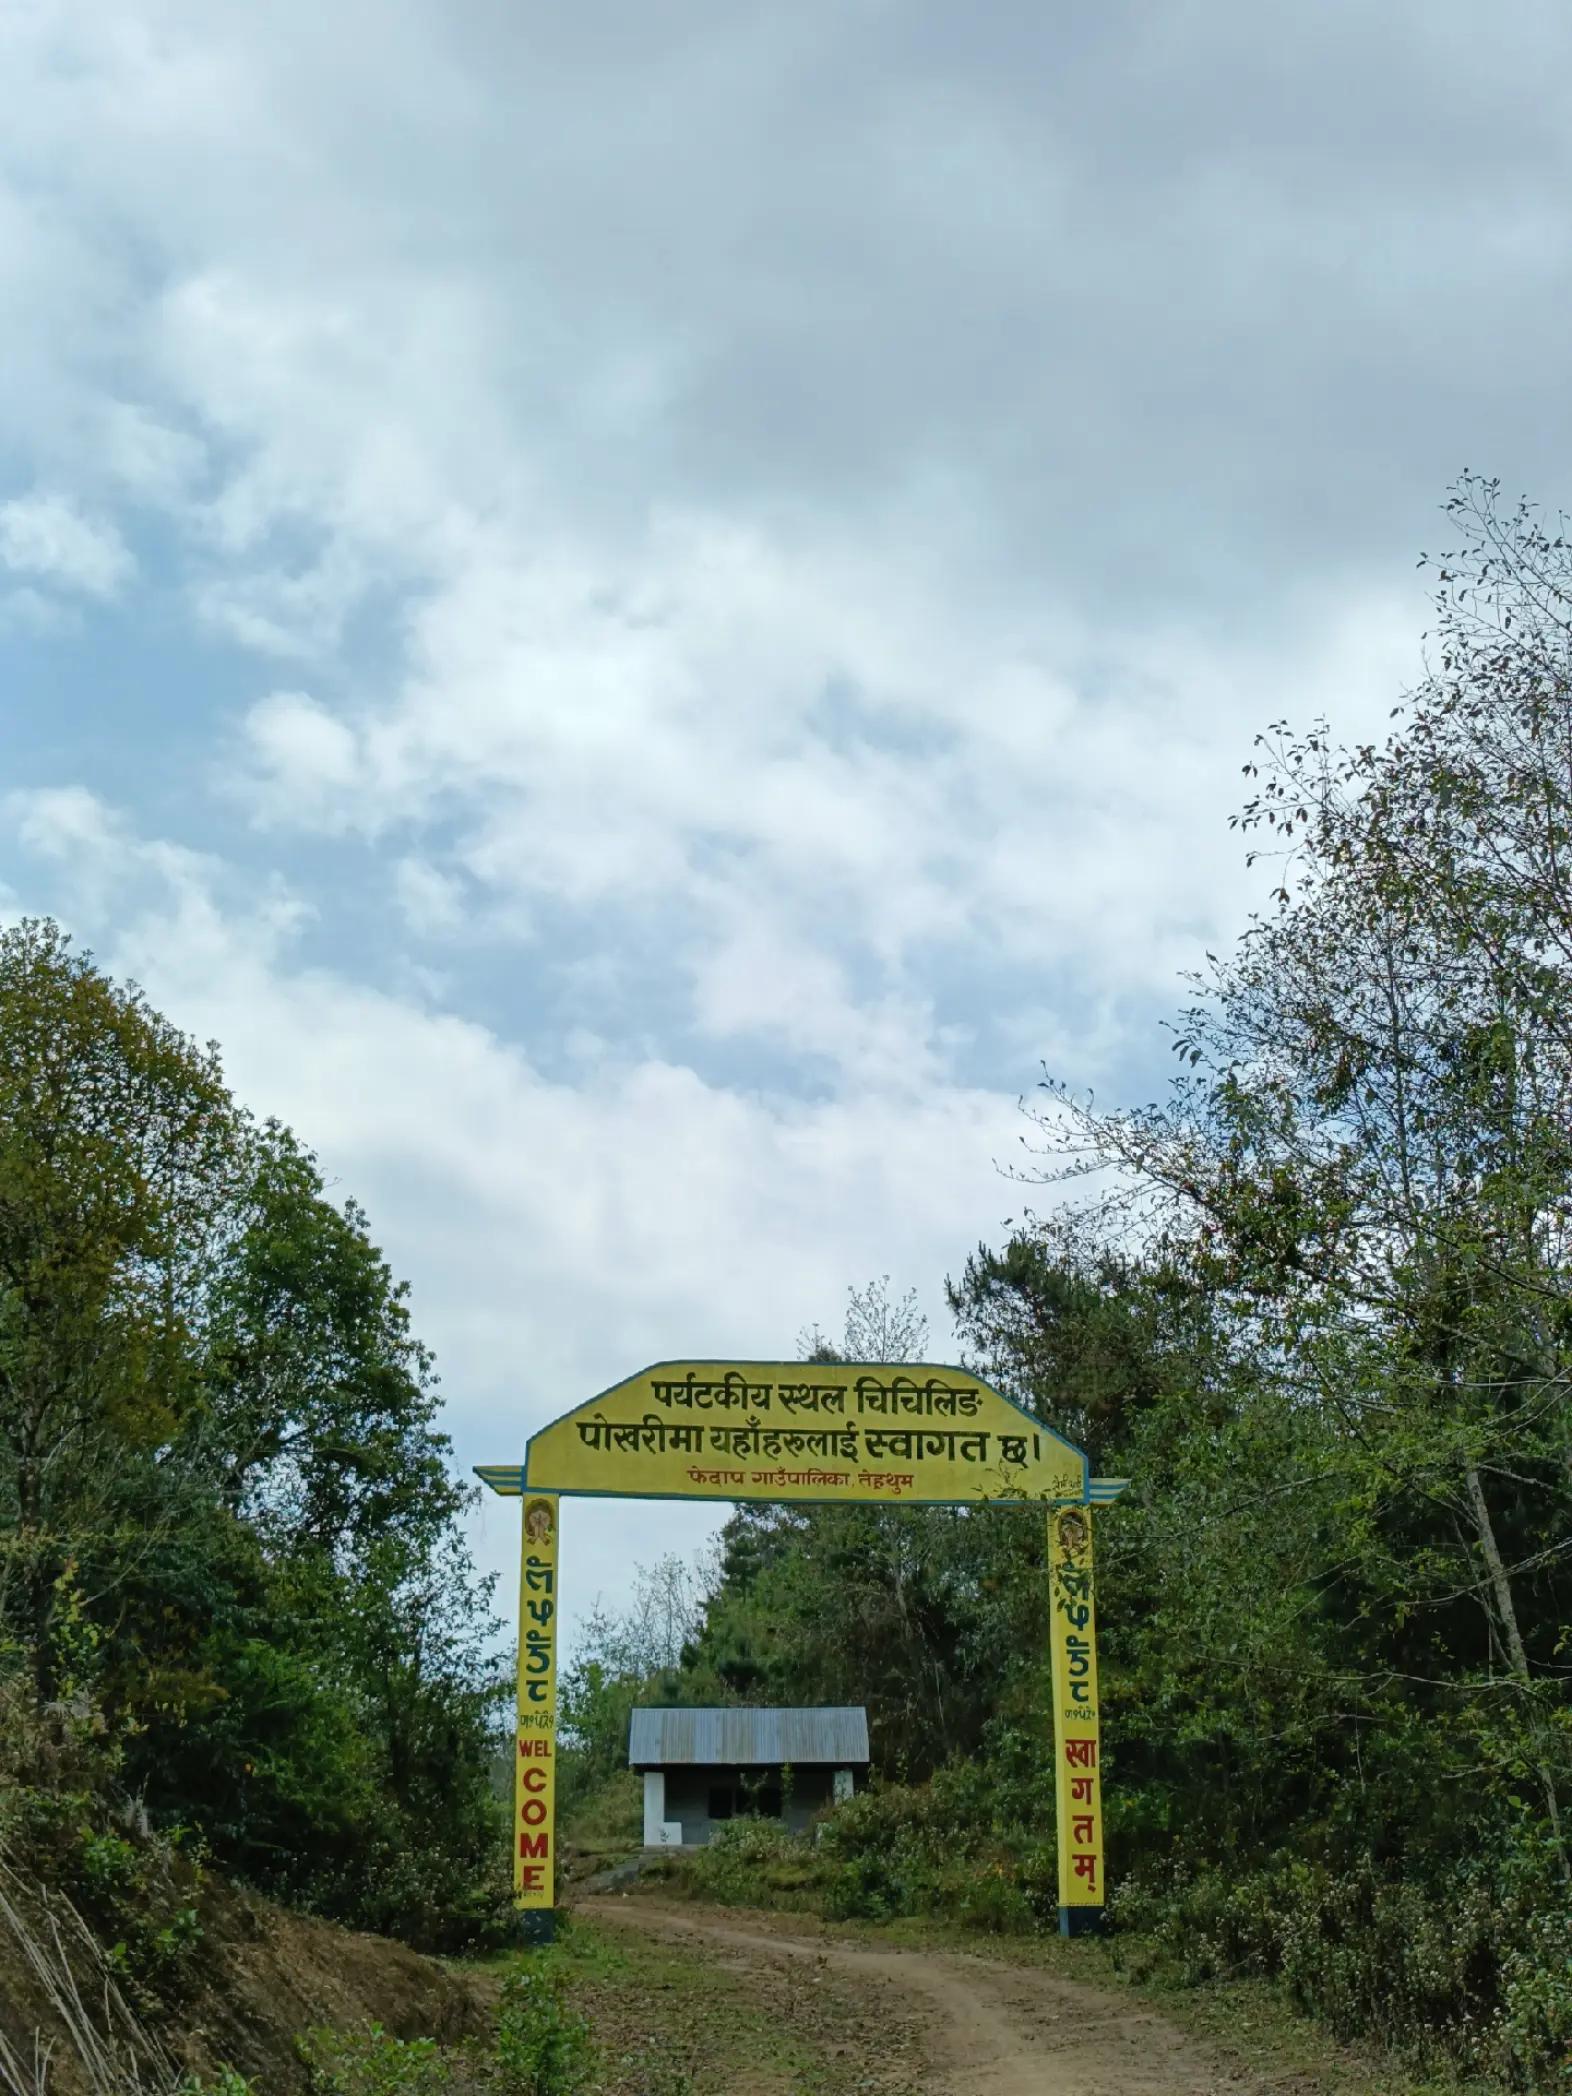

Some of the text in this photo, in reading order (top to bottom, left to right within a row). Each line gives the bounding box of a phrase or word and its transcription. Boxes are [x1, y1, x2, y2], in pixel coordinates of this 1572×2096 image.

[651, 1371, 773, 1410] पर्यटकीय
[778, 1384, 848, 1415] स्थल
[576, 1412, 704, 1454] पोखरीमा
[865, 1429, 991, 1462] स्वागत
[686, 1465, 745, 1488] फेदाप
